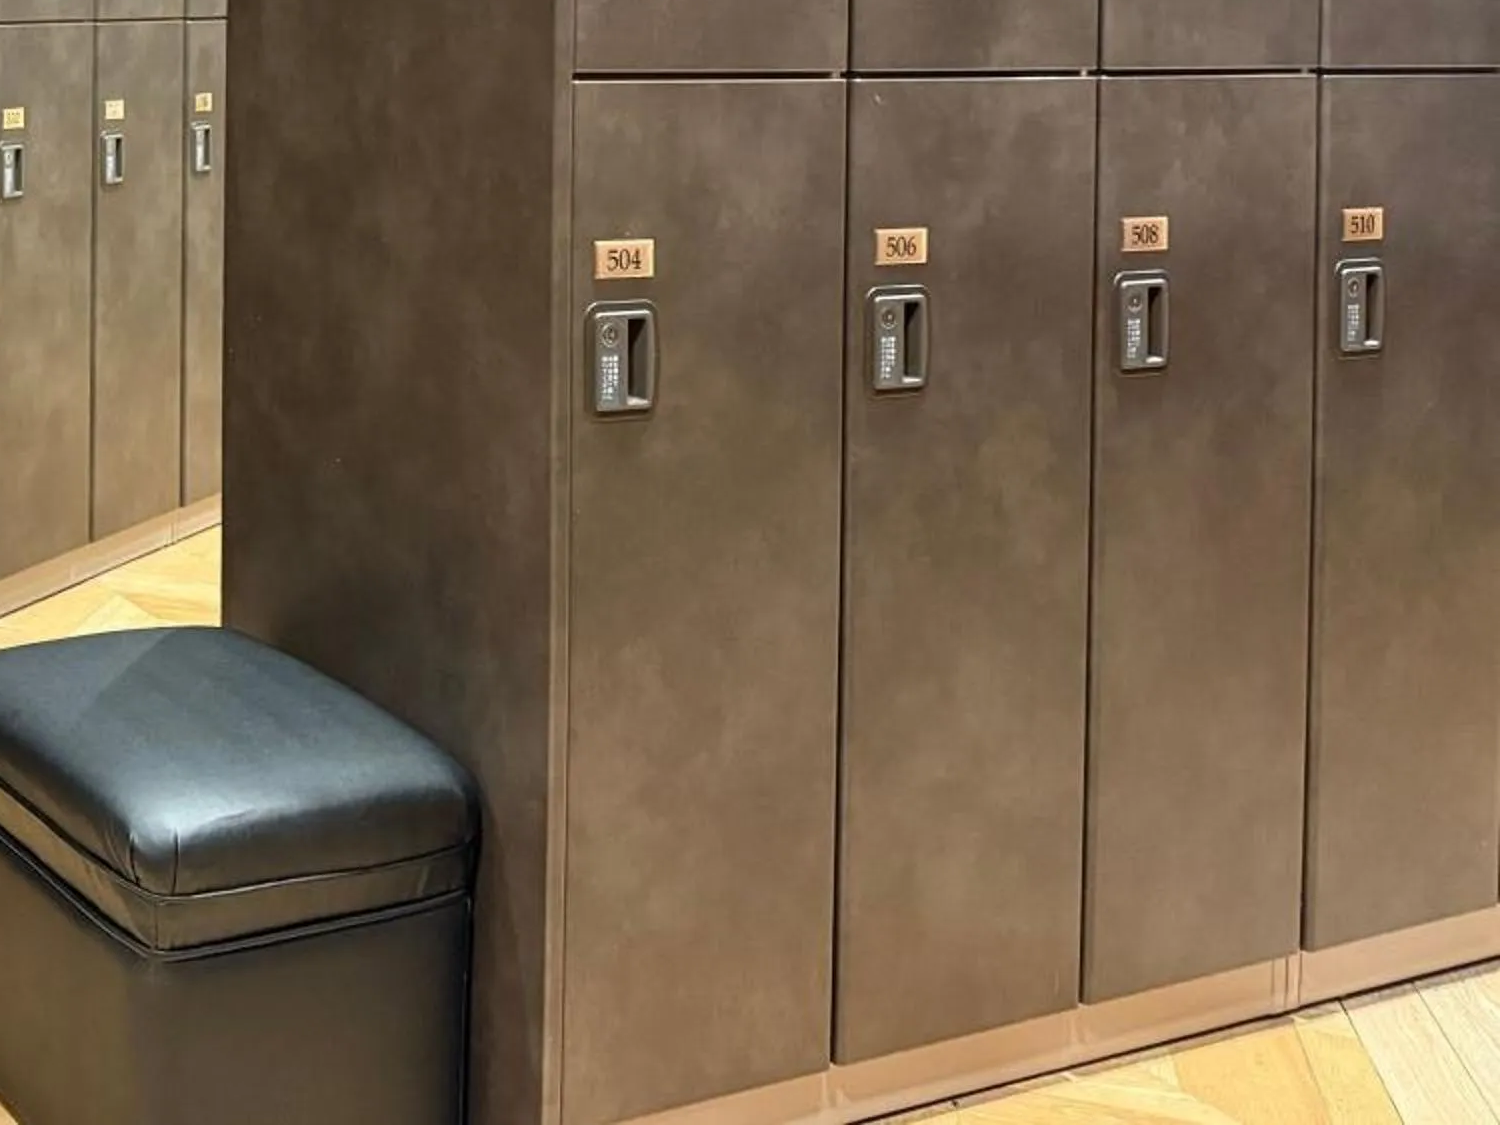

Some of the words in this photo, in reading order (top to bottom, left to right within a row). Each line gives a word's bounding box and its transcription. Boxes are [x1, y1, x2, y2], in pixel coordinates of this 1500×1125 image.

[1131, 223, 1159, 245] 508
[1350, 214, 1376, 234] 510
[885, 236, 917, 257] 506
[606, 248, 642, 272] 504
